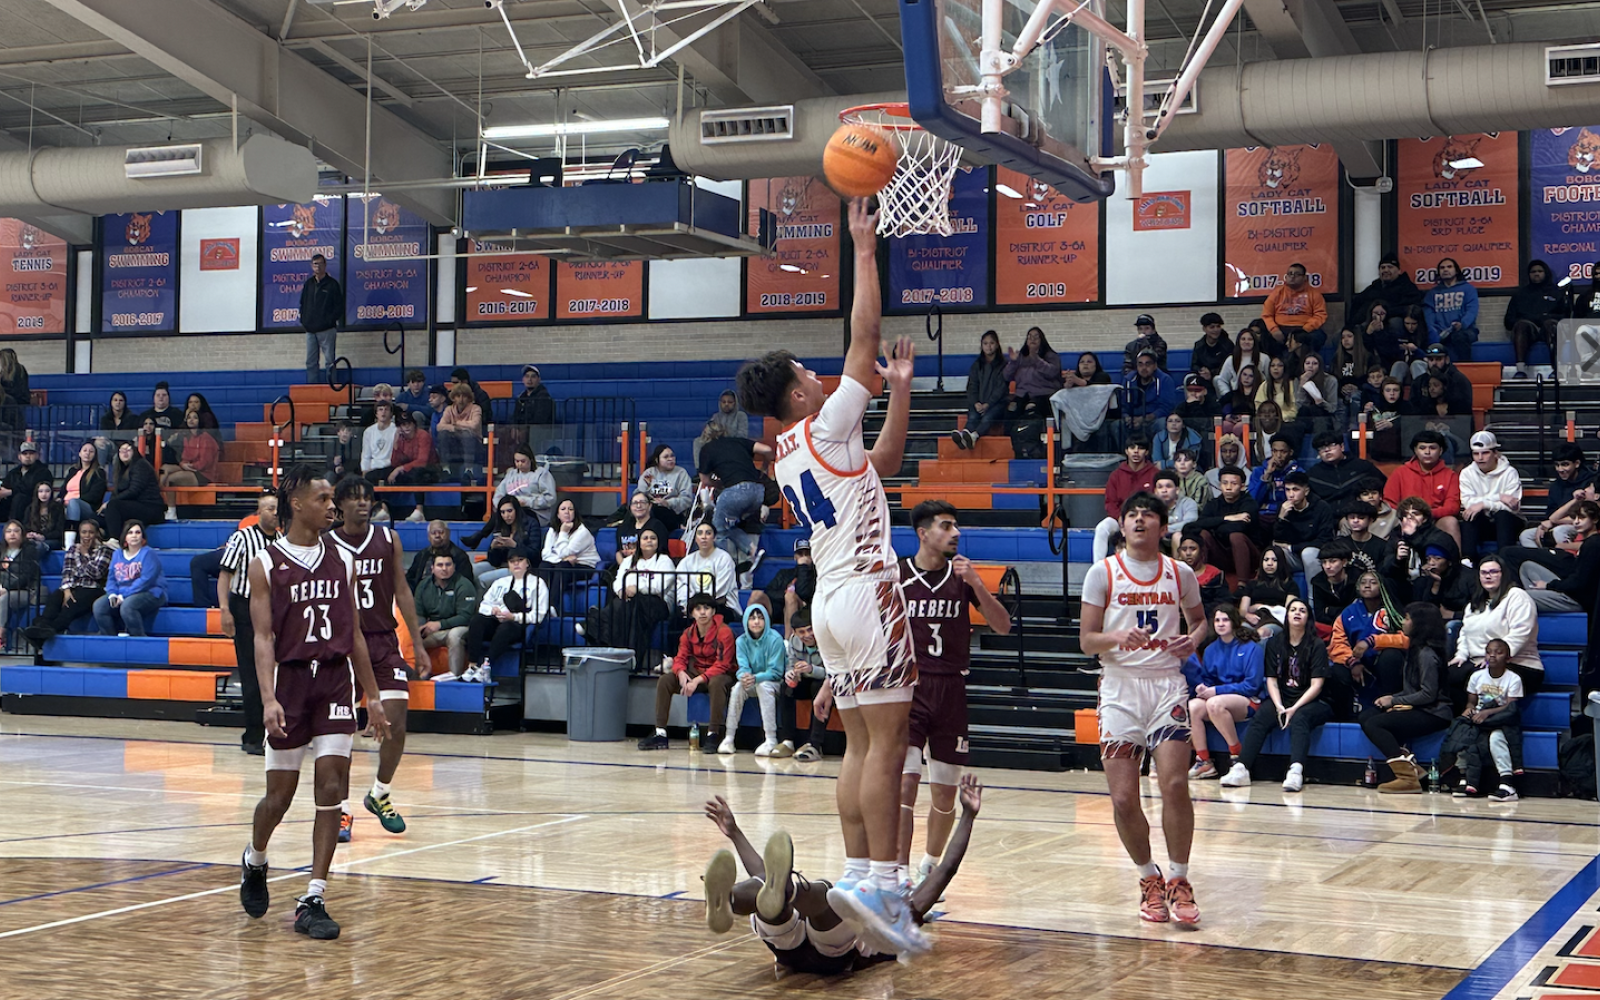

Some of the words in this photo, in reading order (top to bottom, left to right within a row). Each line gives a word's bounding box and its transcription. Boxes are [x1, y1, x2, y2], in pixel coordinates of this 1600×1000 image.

[1424, 181, 1459, 190] LADY
[1464, 179, 1490, 188] CAT
[1251, 190, 1283, 200] LADY
[1287, 188, 1312, 197] CAT
[1410, 187, 1506, 209] SOFTBALL
[1019, 203, 1048, 212] LADY
[1052, 202, 1075, 211] CAT
[1237, 197, 1326, 218] SOFTBALL
[1025, 212, 1067, 228] GOLF
[1423, 217, 1467, 227] DISTRICT
[757, 223, 834, 239] IMMING
[1247, 226, 1315, 240] BI-DISTRICT
[1456, 226, 1485, 235] PLACE
[354, 242, 420, 258] SWIMMING
[908, 246, 968, 258] BI-DISTRICT
[1009, 241, 1056, 253] DISTRICT
[1059, 241, 1086, 251] 3-6A
[1254, 242, 1309, 253] QUALIFIER
[1404, 244, 1459, 254] BI-DISTRICT
[1462, 241, 1512, 252] QUALIFIER
[1544, 242, 1597, 254] REGIONAL
[11, 257, 53, 271] TENNIS
[109, 252, 169, 268] SWIMMING
[911, 260, 964, 271] QUALIFIER
[1017, 253, 1077, 265] RUNNER-UP
[355, 269, 393, 279] DISTRICT
[478, 262, 516, 272] DISTRICT
[484, 273, 531, 283] CHAMPION
[574, 270, 625, 280] RUNNER-UP
[5, 282, 38, 292] DISTRICT
[111, 278, 146, 288] DISTRICT
[363, 280, 409, 291] CHAMPION
[118, 289, 159, 299] CHAMPION
[901, 287, 973, 303] 2017-2018
[1026, 283, 1066, 298] 2019
[568, 298, 630, 313] 2017-2018
[761, 291, 827, 307] 2018-2019
[1434, 291, 1464, 308] CHS
[356, 304, 415, 319] 2018-2019
[478, 300, 537, 315] 2016-2017
[17, 316, 45, 329] 2019
[111, 312, 164, 326] 2016-2017
[355, 558, 384, 575] BELS
[1118, 591, 1176, 606] CENTRAL
[908, 599, 961, 618] REBELS
[303, 604, 333, 643] 23
[1136, 610, 1158, 635] 15
[927, 623, 943, 657] 3
[328, 702, 352, 720] LHS
